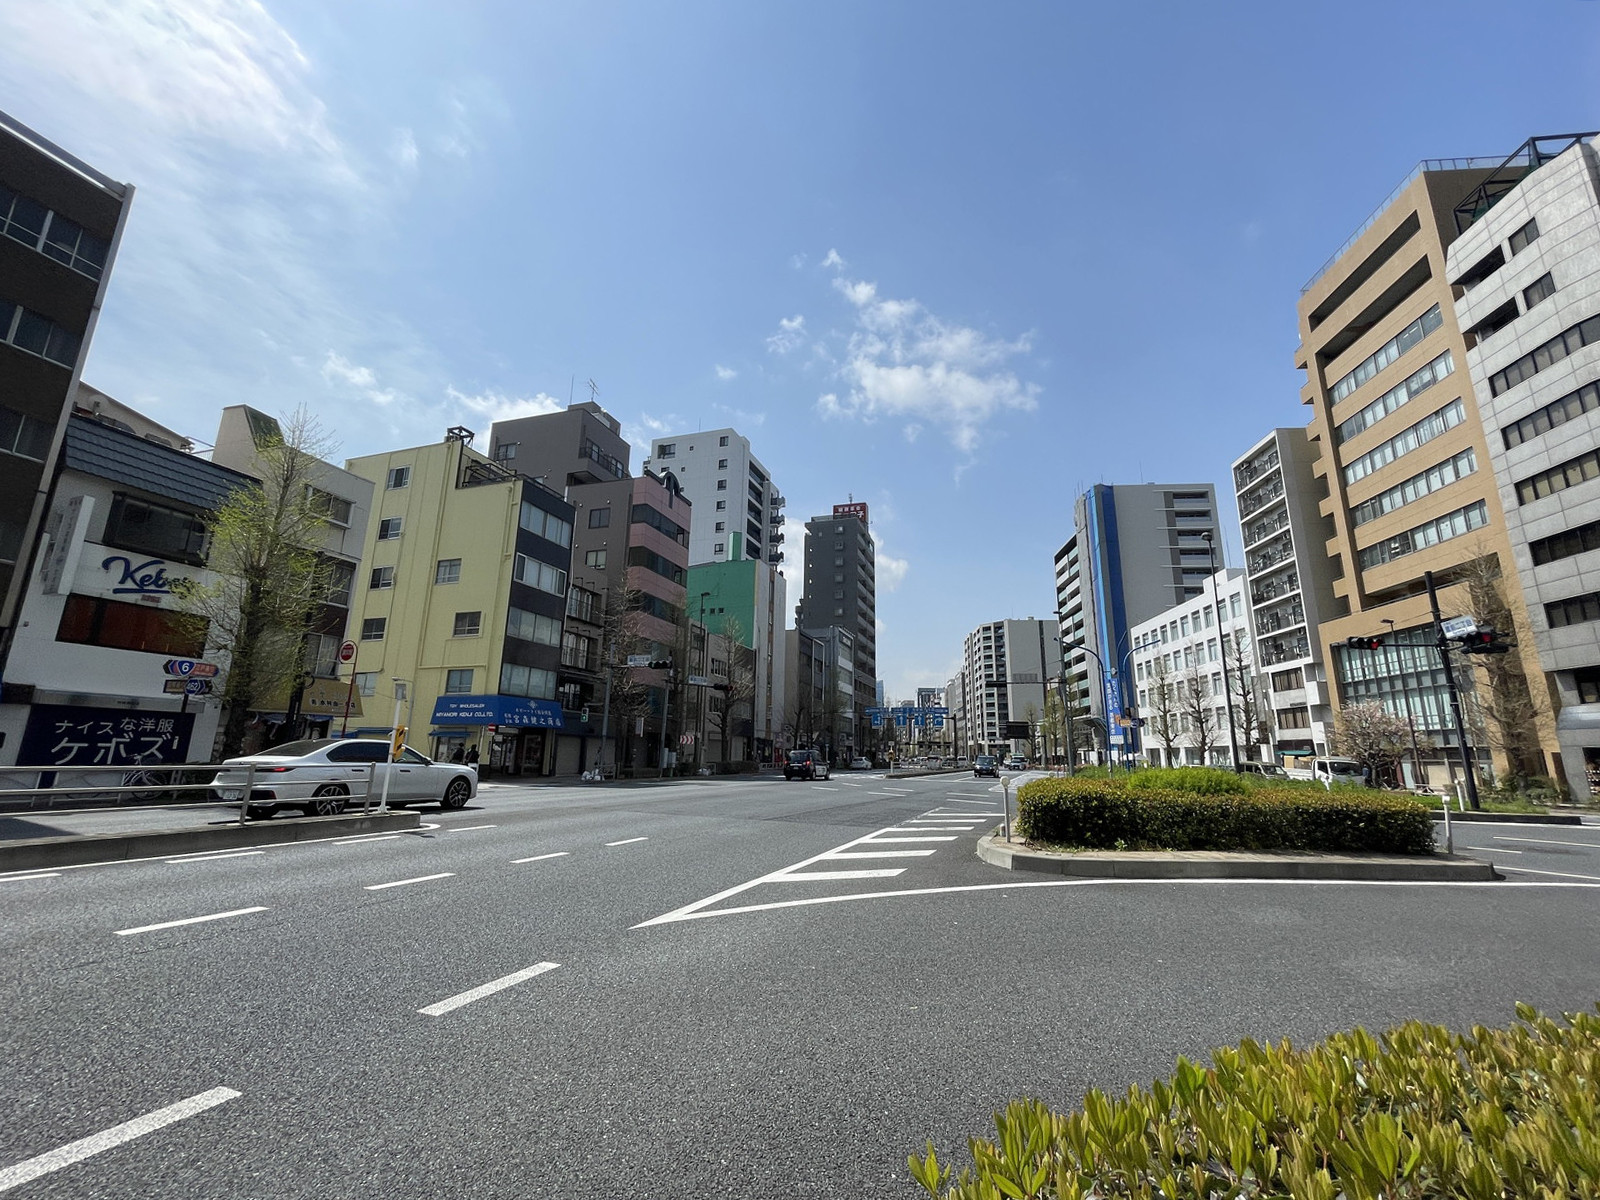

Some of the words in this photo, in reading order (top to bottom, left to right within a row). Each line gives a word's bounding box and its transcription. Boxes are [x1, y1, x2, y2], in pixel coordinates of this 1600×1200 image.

[182, 662, 190, 672] 6
[55, 717, 175, 735] ナイスな洋服
[51, 732, 172, 765] ケボズ
